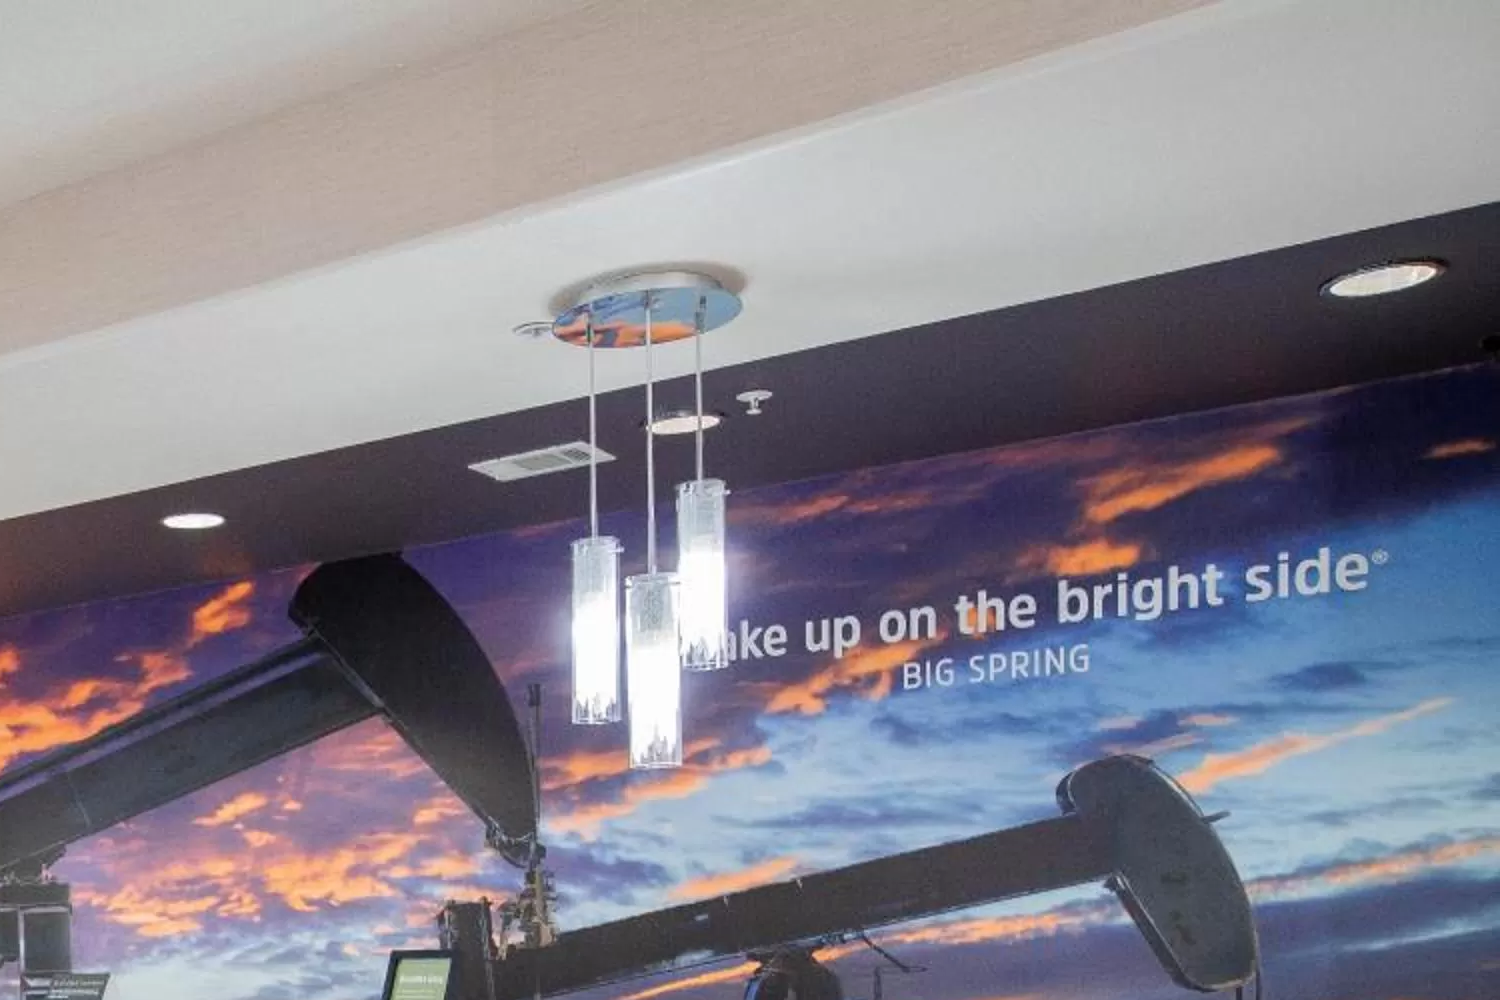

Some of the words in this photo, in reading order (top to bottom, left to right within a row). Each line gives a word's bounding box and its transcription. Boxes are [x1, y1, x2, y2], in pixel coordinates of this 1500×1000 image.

[804, 614, 862, 659] up
[878, 604, 938, 643] on
[954, 589, 1037, 635] the
[1057, 563, 1225, 624] bright
[902, 657, 955, 690] BIG
[968, 643, 1090, 684] SPRING
